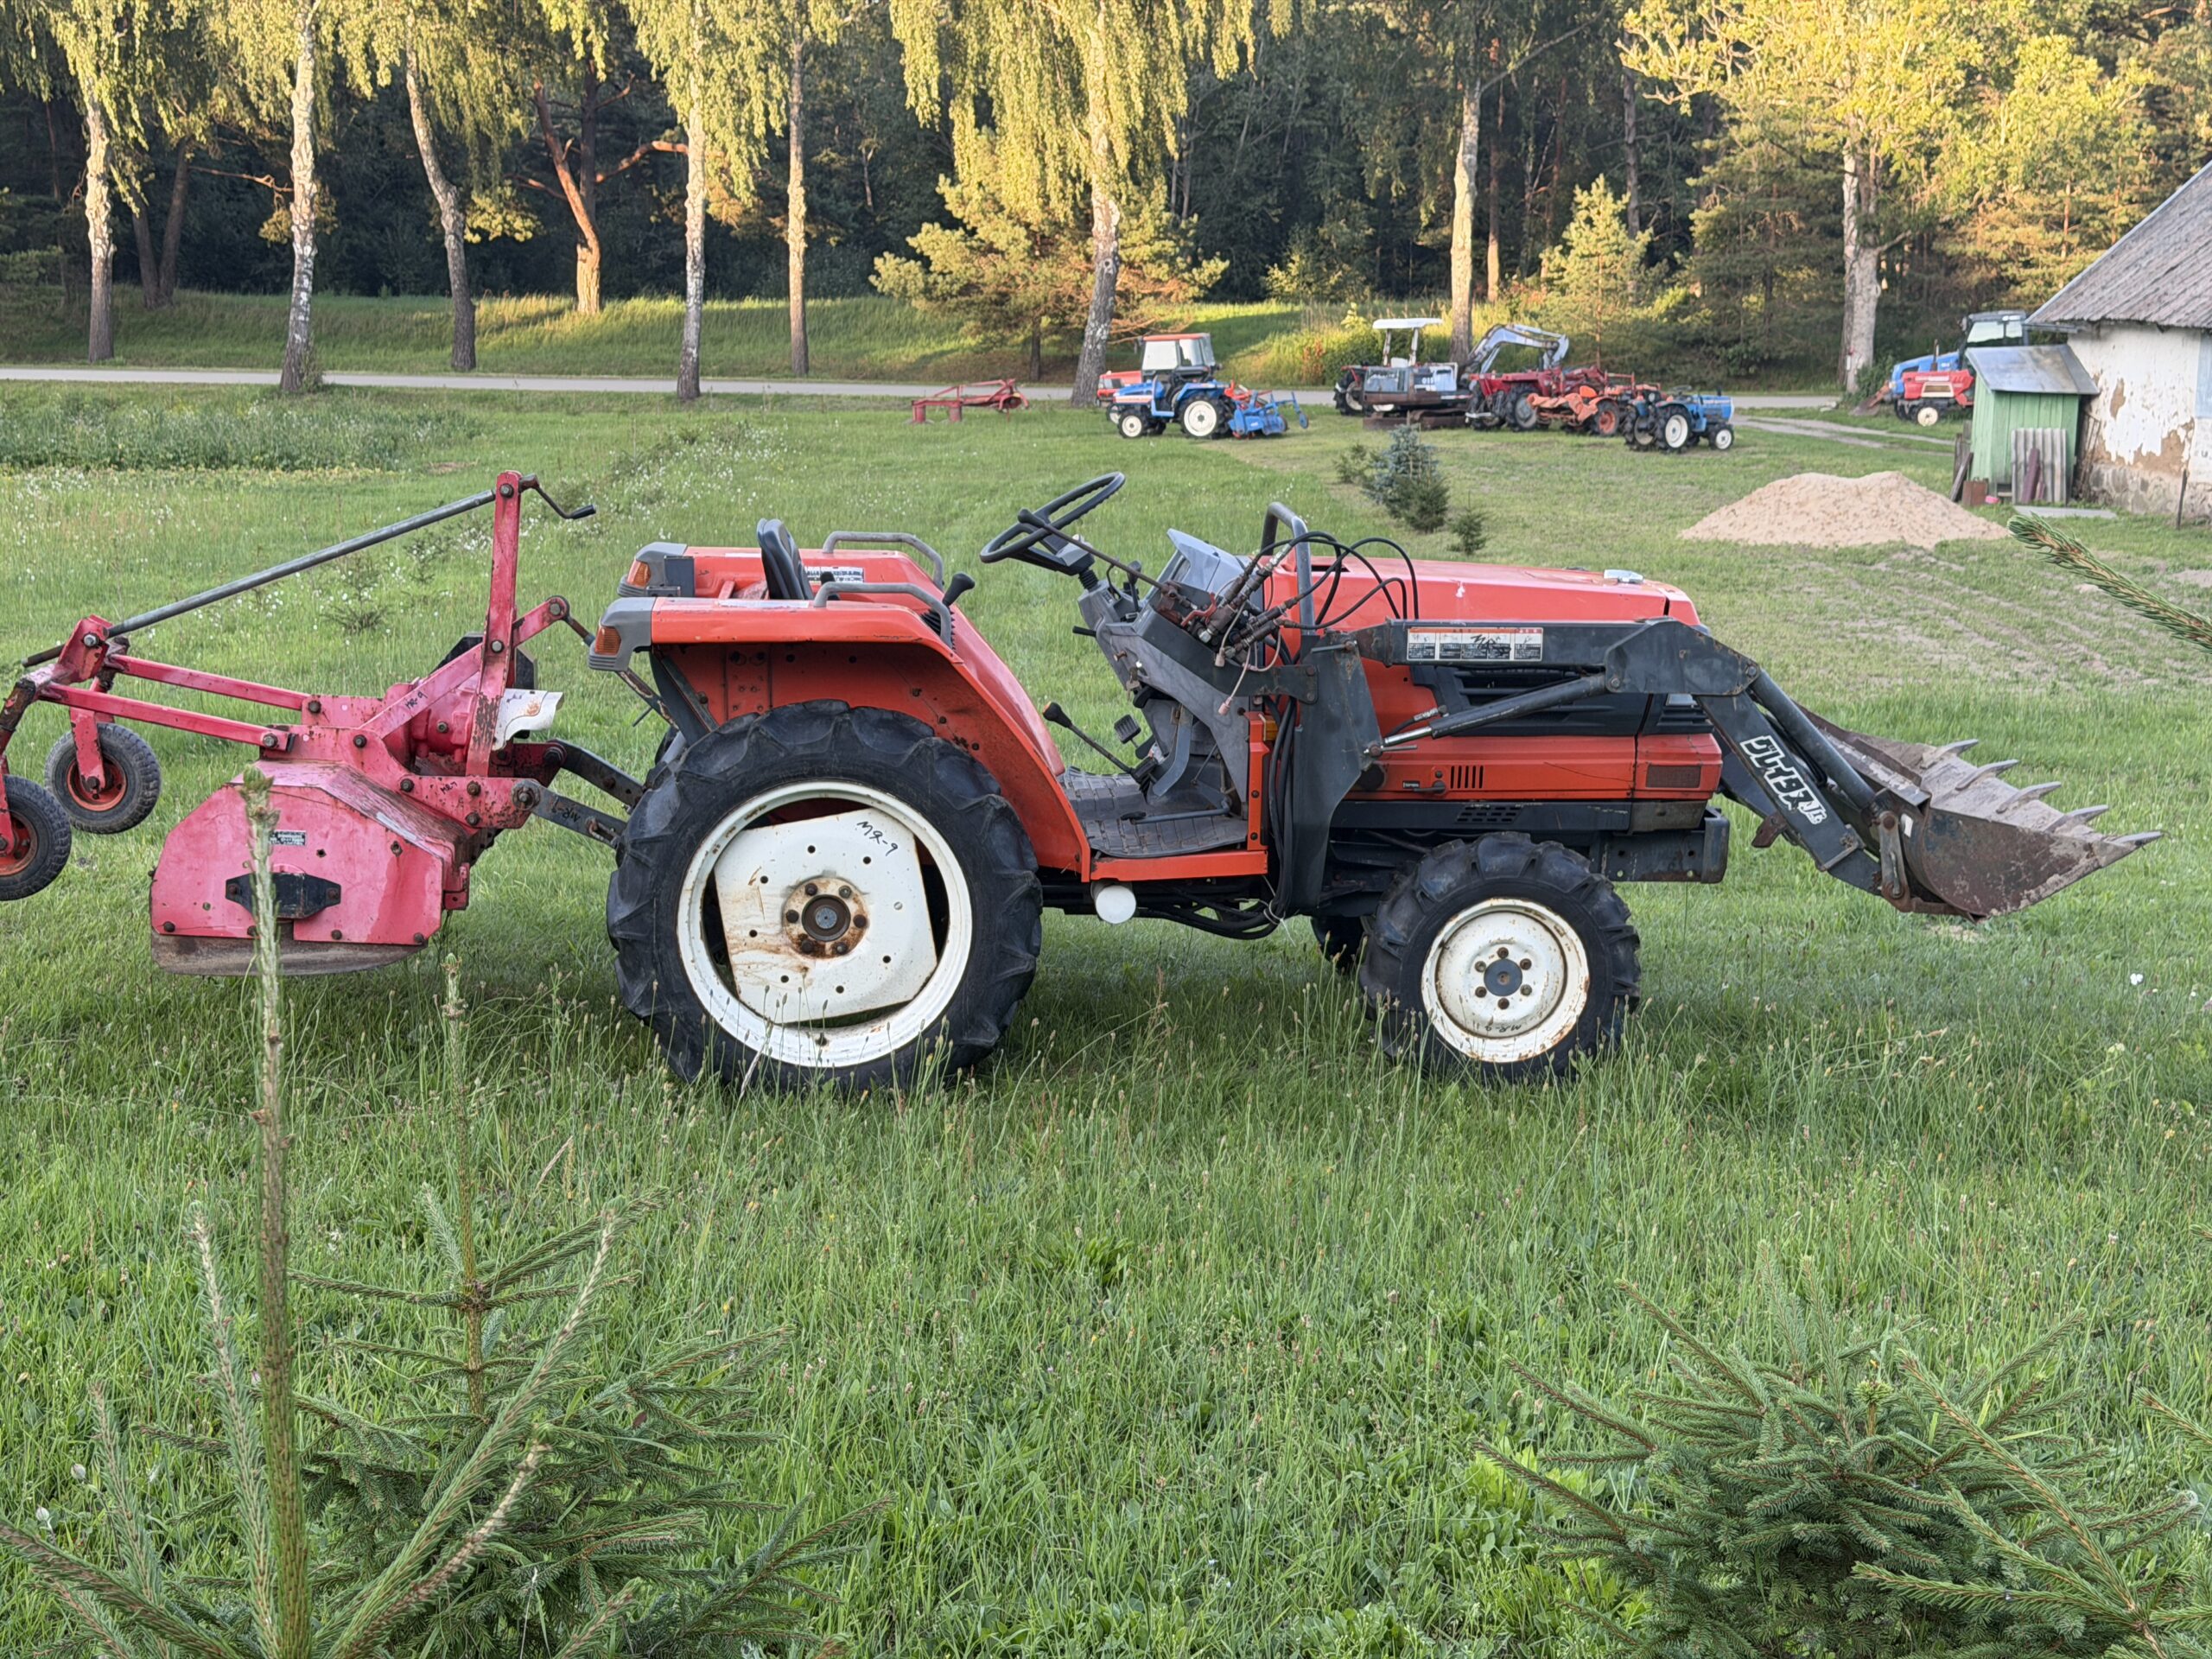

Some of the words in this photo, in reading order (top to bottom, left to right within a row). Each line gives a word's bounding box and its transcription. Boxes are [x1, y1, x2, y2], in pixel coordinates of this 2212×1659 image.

[1739, 735, 1816, 810] グレイタス
[856, 821, 899, 857] MR-9
